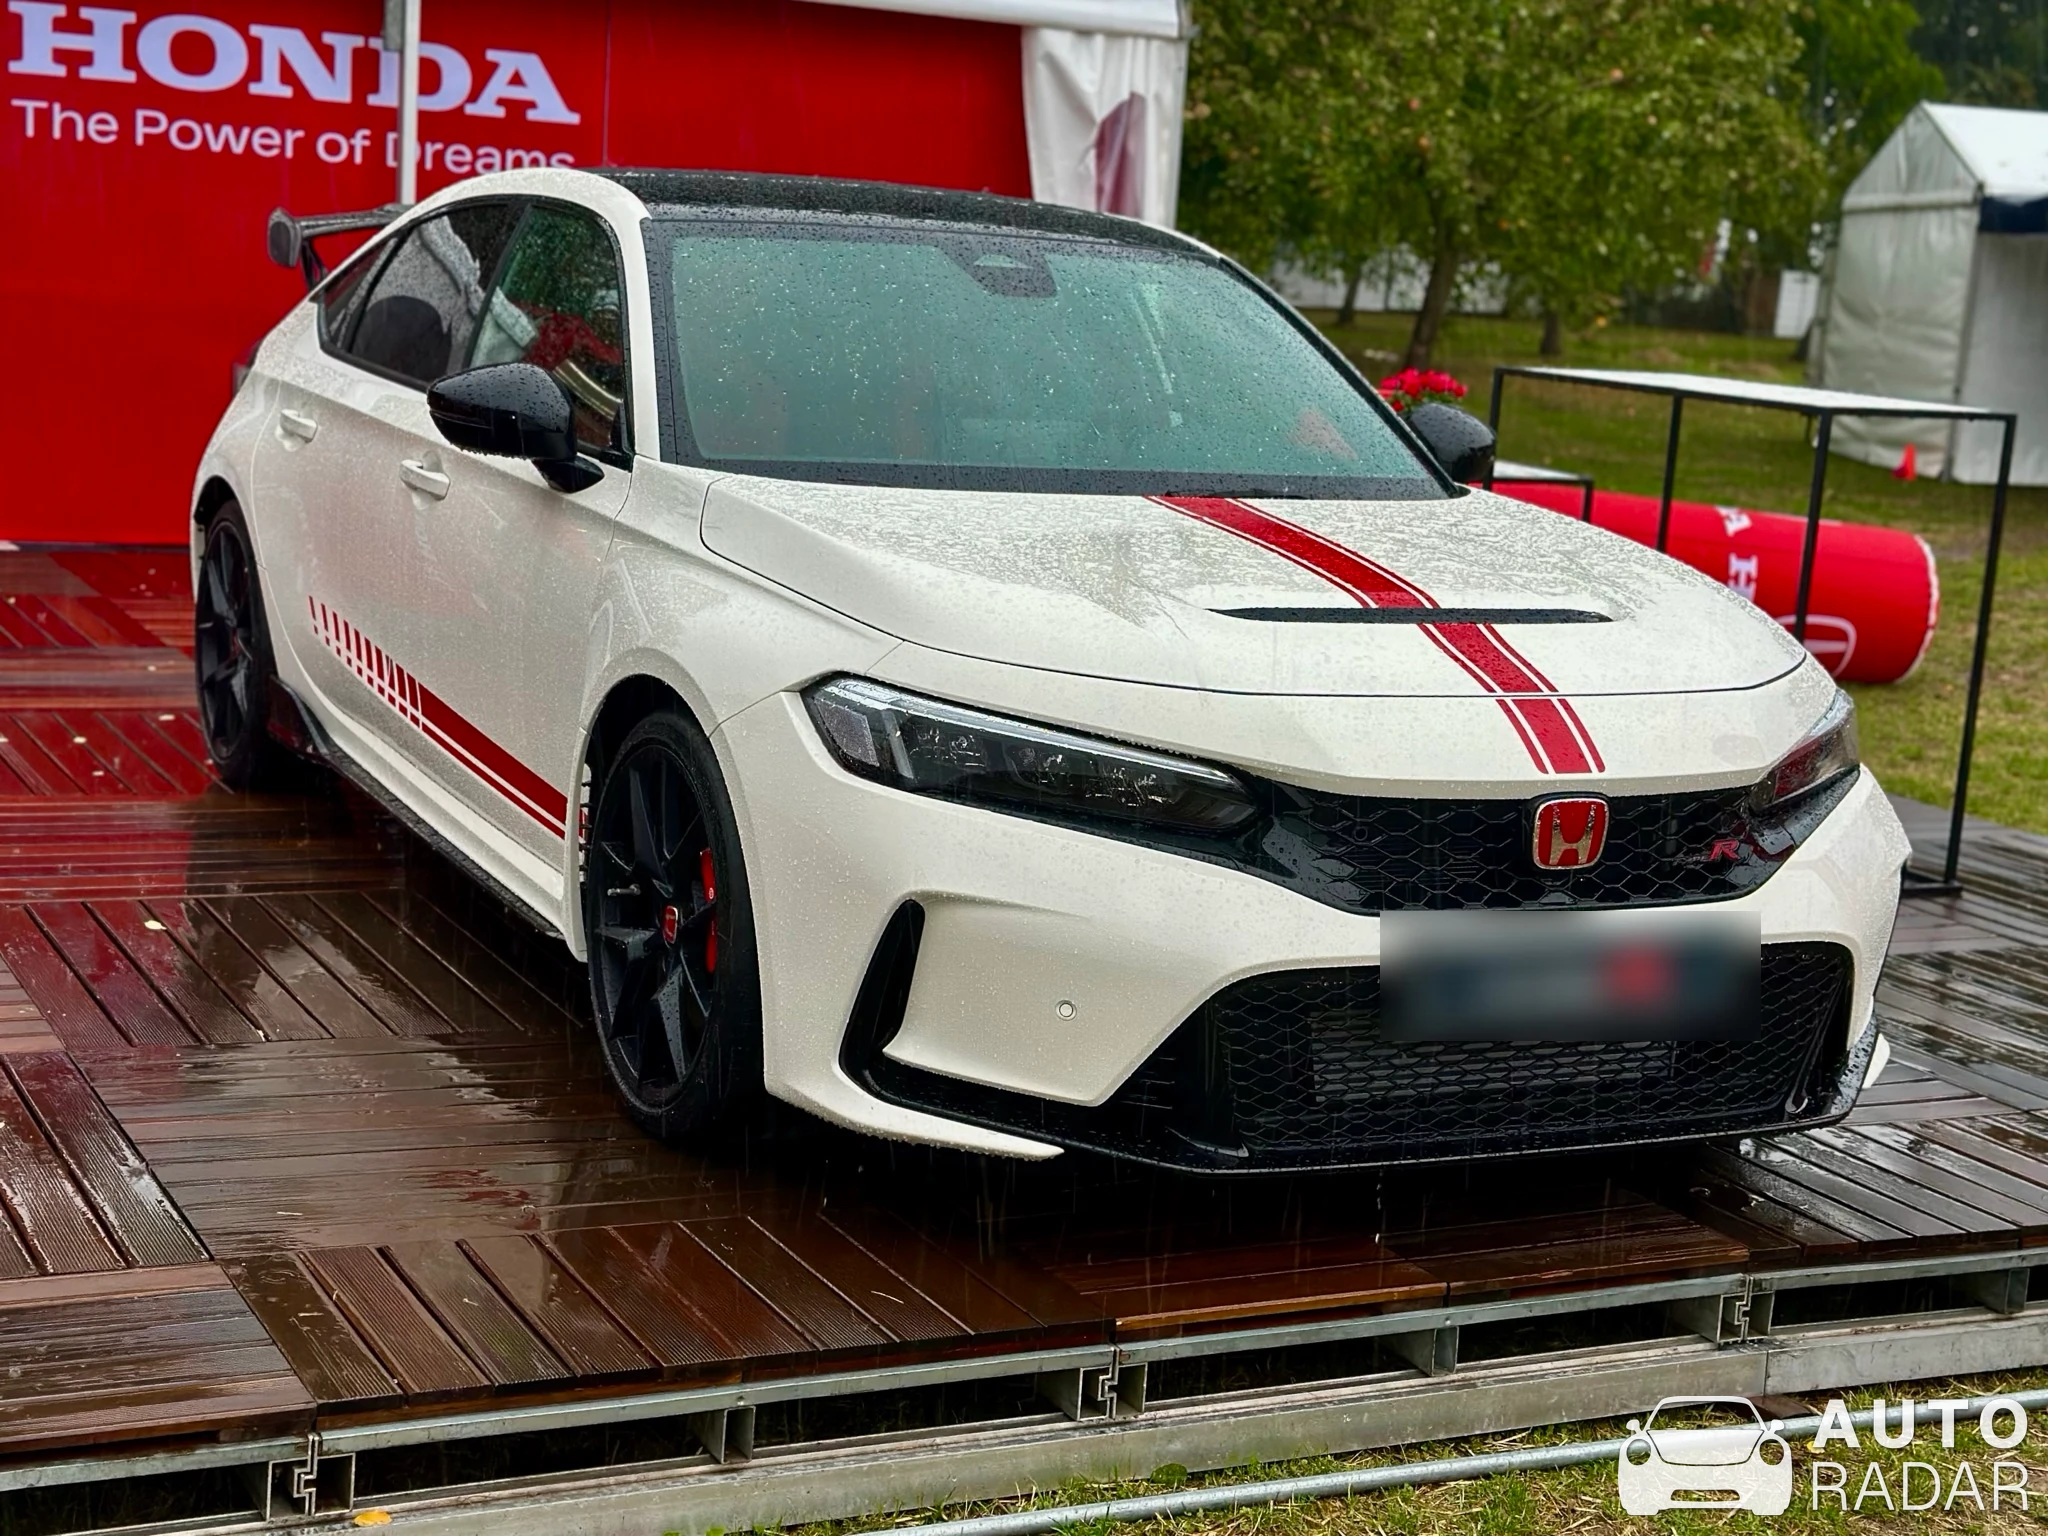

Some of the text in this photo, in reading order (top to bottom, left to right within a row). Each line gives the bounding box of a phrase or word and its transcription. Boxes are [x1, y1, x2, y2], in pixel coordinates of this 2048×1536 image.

[8, 1, 581, 126] HONDA
[11, 99, 118, 144] The
[135, 109, 305, 160] Power
[315, 128, 371, 165] of
[1709, 838, 1740, 862] R
